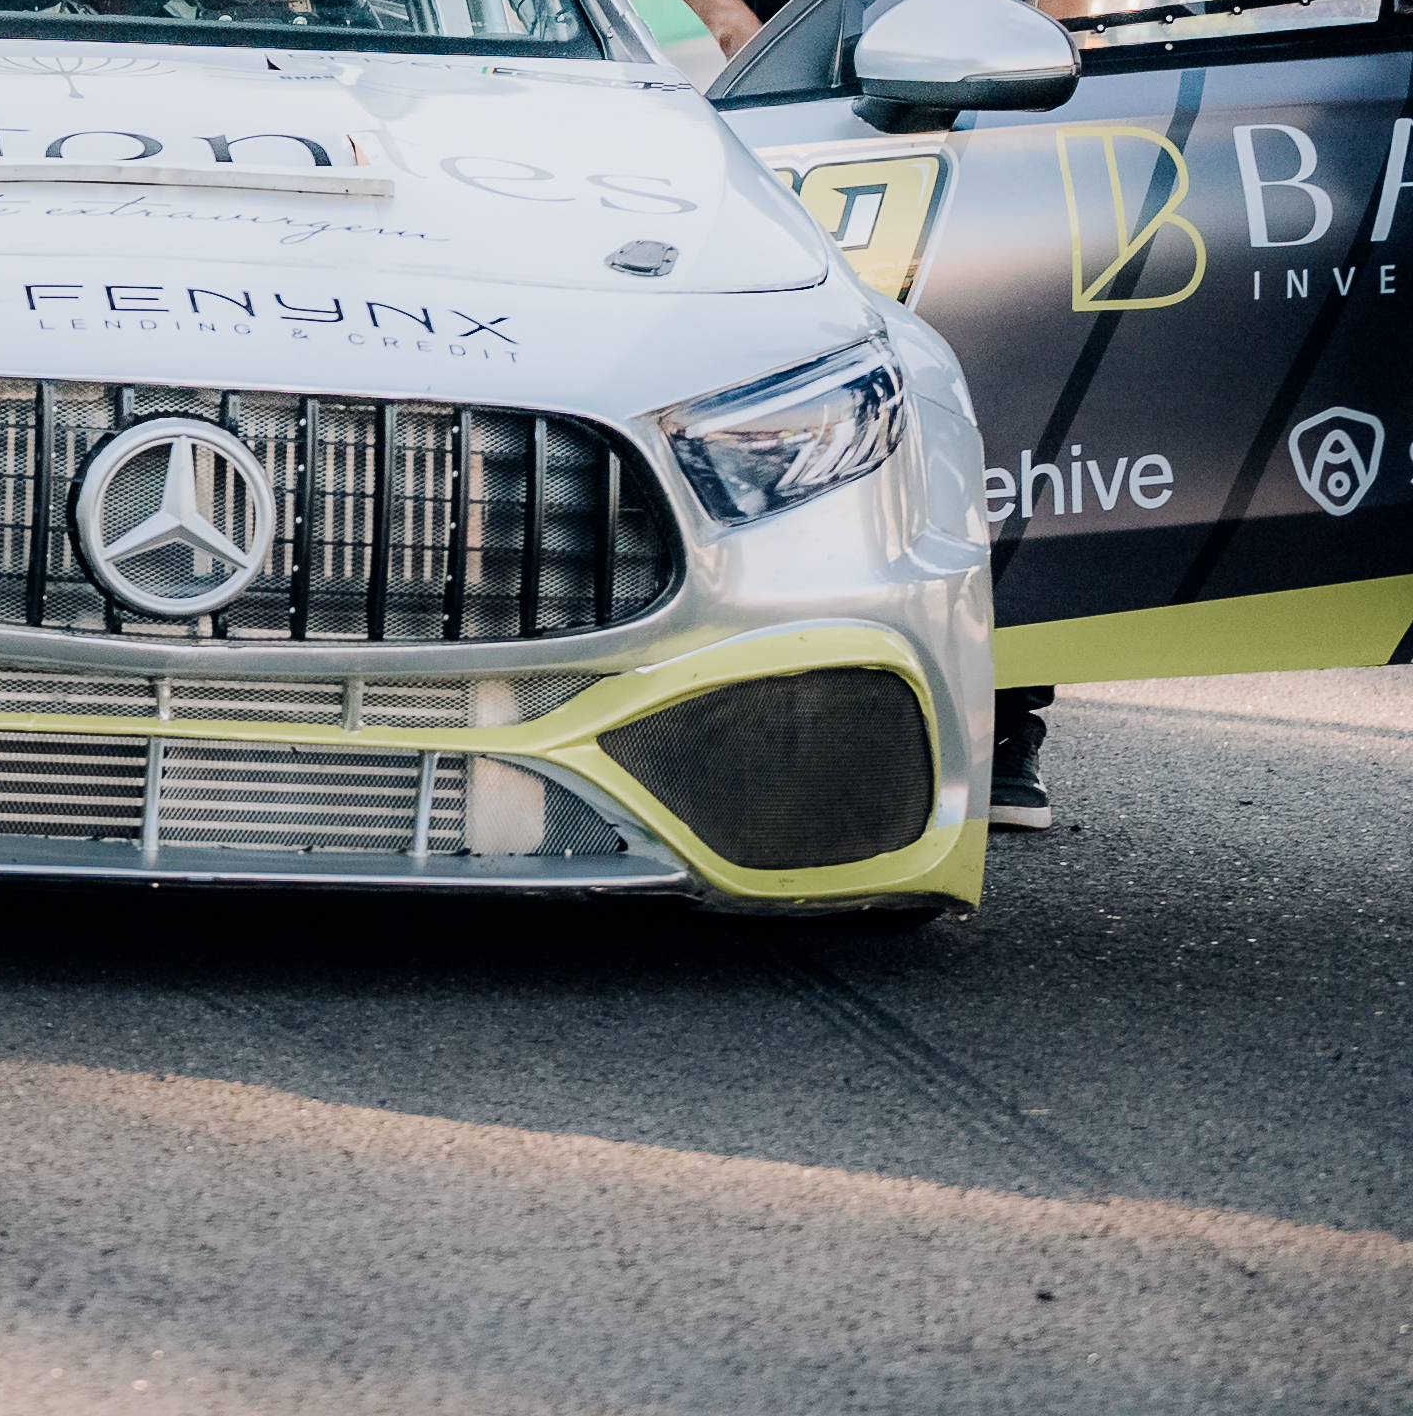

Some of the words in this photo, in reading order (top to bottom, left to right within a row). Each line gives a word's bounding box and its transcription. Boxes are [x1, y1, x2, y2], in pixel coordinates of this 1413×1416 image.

[24, 284, 520, 345] FENYNX
[39, 319, 253, 336] LENDING
[291, 327, 310, 340] &
[347, 332, 521, 365] CREDIT
[984, 443, 1174, 523] ehive
